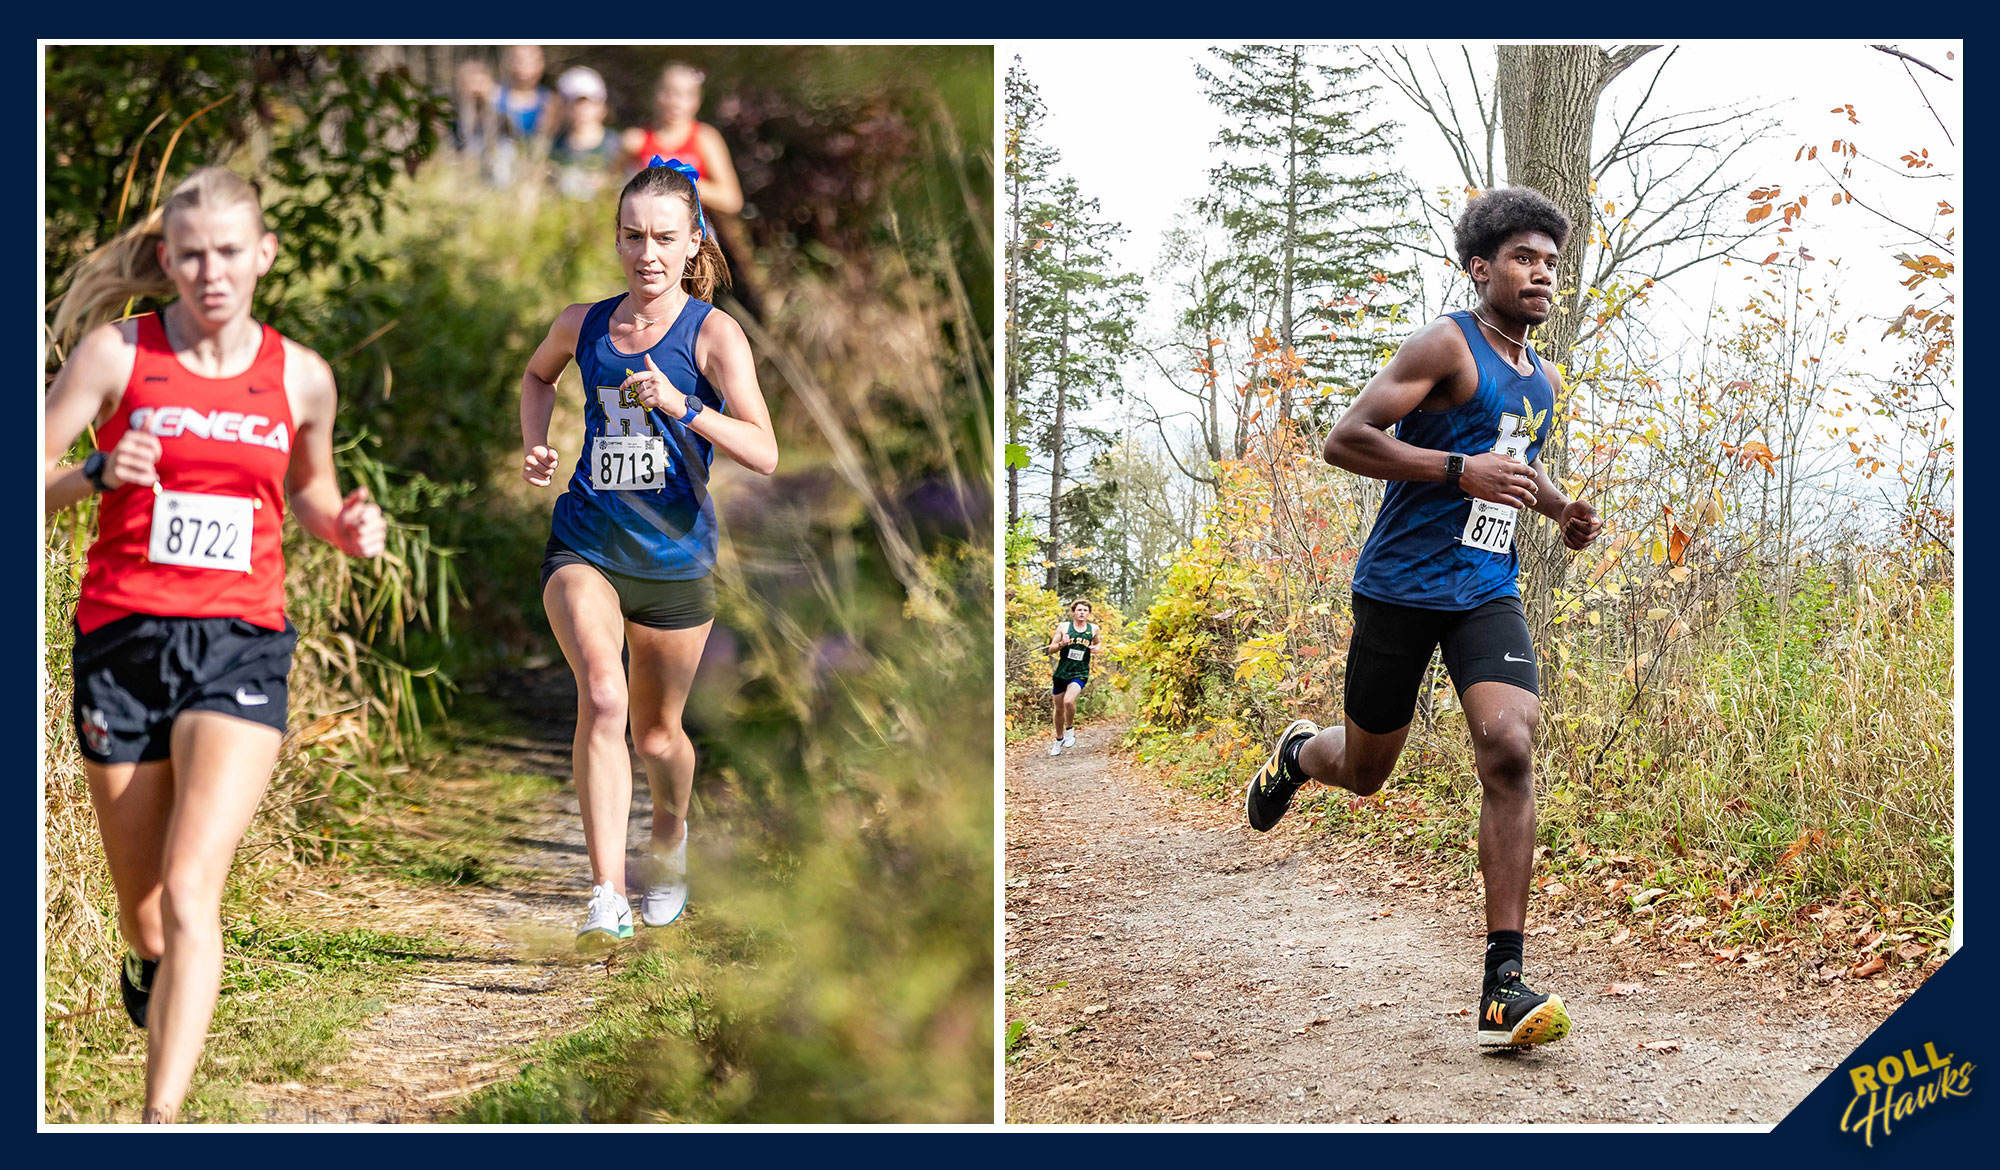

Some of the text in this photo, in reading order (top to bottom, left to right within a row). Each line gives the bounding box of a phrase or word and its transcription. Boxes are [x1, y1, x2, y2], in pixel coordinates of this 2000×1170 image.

[601, 452, 654, 485] 8713
[166, 517, 238, 559] 8722
[1471, 515, 1511, 548] 8775
[1486, 1000, 1506, 1024] N
